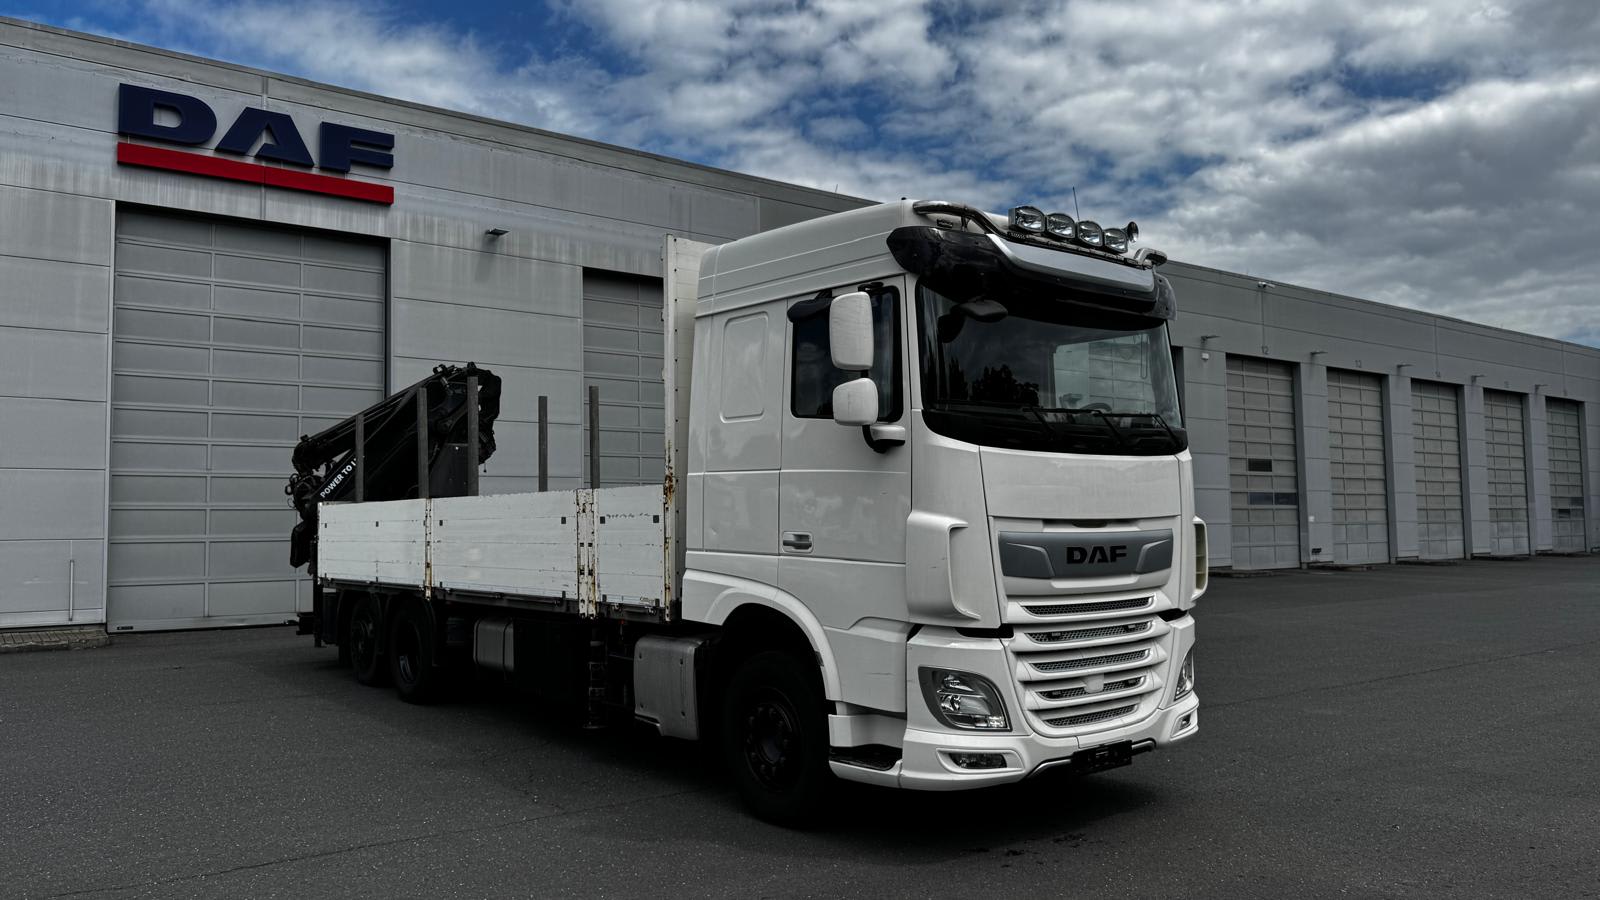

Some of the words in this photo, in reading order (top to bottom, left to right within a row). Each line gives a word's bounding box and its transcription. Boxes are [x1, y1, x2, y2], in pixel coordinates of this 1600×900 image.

[118, 83, 395, 173] DAF
[320, 474, 344, 498] POWER
[341, 465, 352, 475] TO
[1066, 545, 1127, 564] DAF
